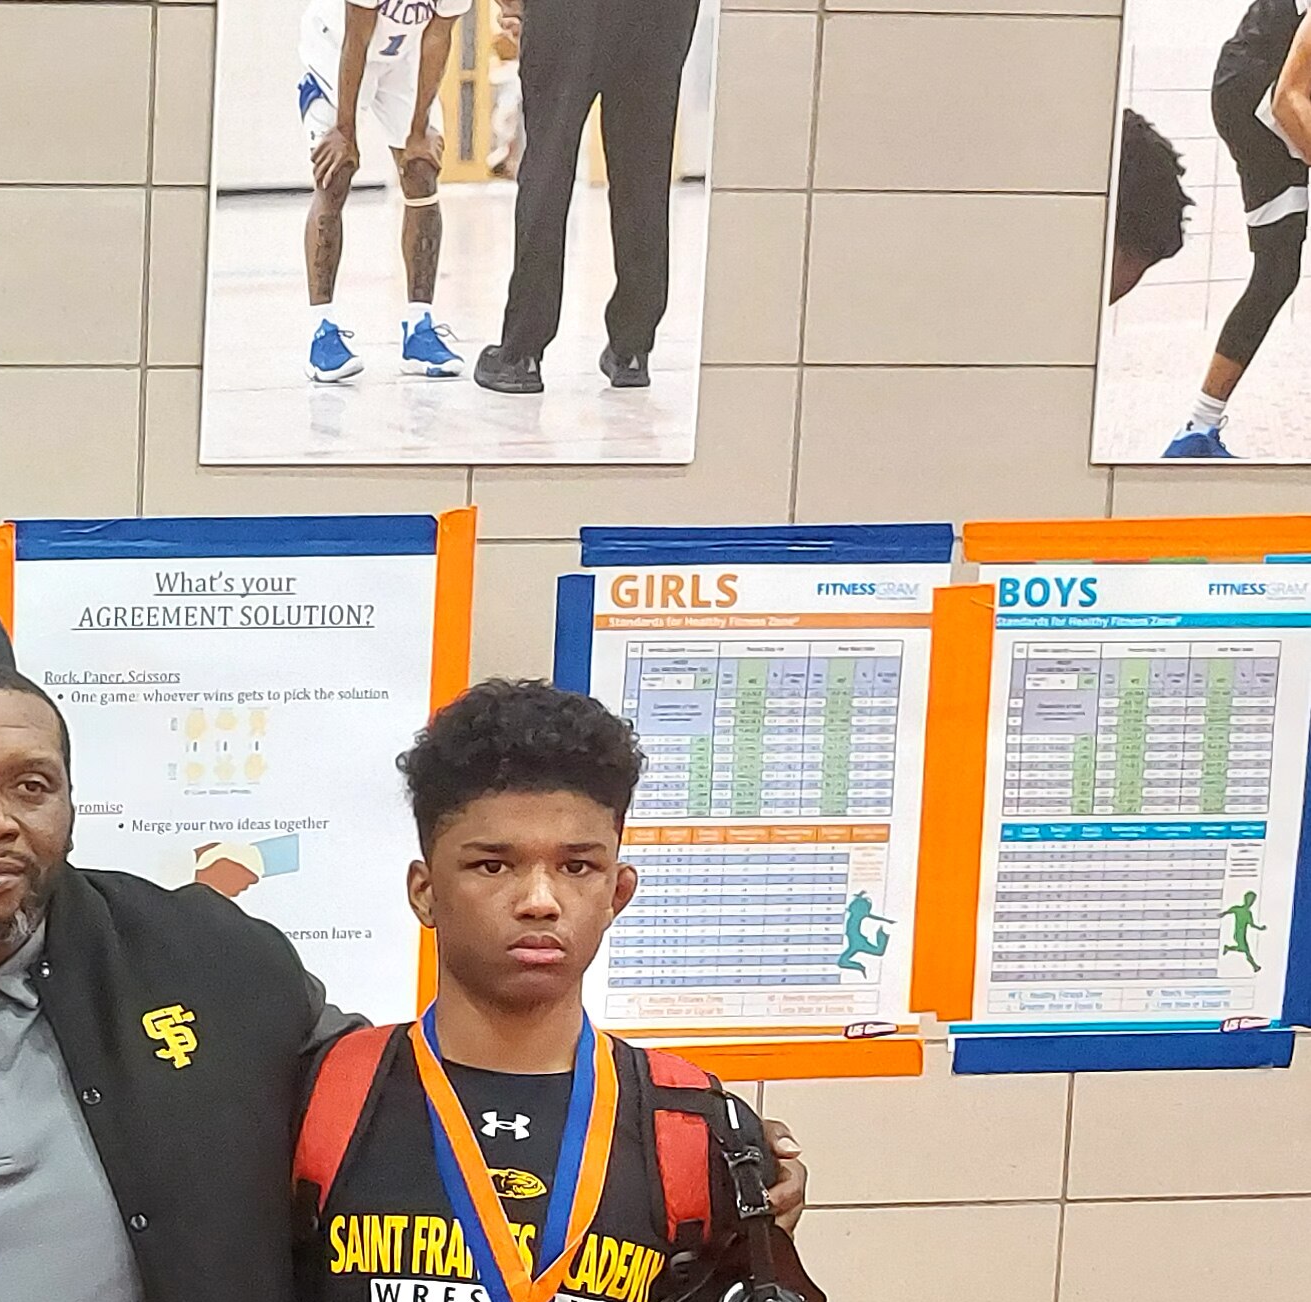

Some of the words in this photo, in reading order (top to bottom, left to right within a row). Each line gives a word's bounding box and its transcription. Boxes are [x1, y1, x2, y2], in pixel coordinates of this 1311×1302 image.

[379, 34, 408, 56] 1
[154, 571, 235, 595] What's
[240, 574, 297, 598] your
[610, 573, 739, 608] GIRLS
[998, 577, 1098, 608] BOYS
[77, 605, 234, 628] AGREEMENT
[239, 604, 375, 627] SOLUTION?
[127, 670, 181, 683] Scissors
[71, 690, 99, 703] One
[143, 689, 200, 702] whoever
[203, 689, 234, 702] wins
[235, 690, 264, 704] gets
[267, 689, 281, 701] to
[284, 687, 311, 704] pick
[314, 687, 335, 700] the
[337, 686, 389, 699] solution
[75, 802, 124, 815] romise
[131, 819, 172, 834] Merge
[174, 820, 207, 834] your
[209, 820, 234, 831] two
[236, 818, 272, 831] ideas
[273, 818, 329, 833] together
[331, 926, 363, 940] have
[365, 930, 373, 939] a
[329, 1214, 410, 1275] SAINT
